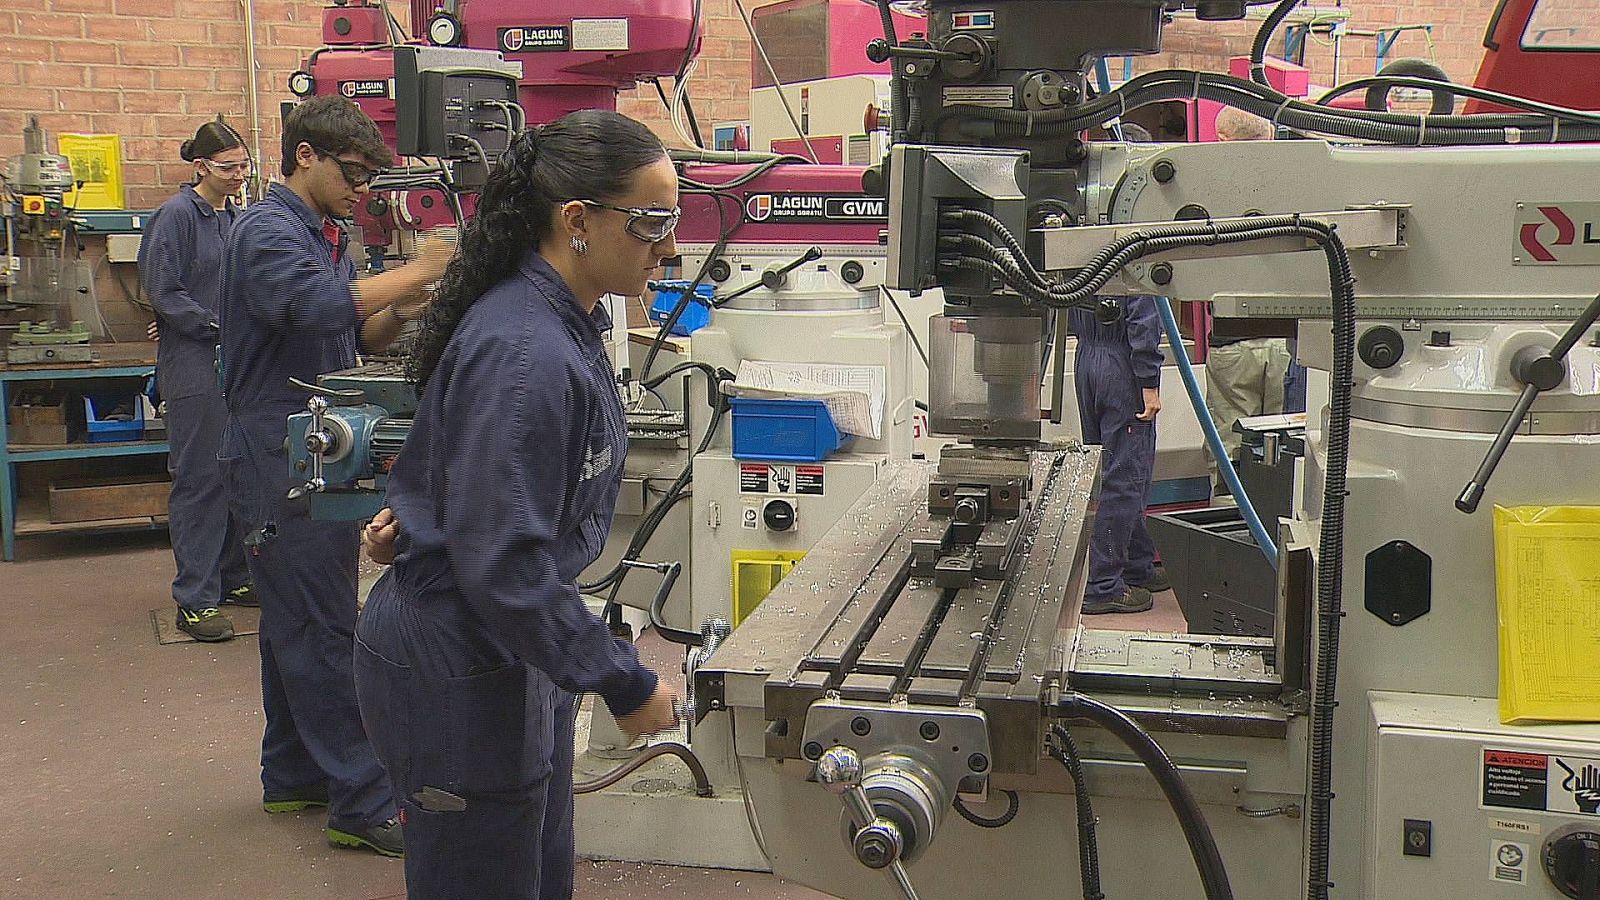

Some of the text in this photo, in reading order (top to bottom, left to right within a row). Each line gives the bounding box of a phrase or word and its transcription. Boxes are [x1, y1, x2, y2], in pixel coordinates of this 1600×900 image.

[524, 29, 563, 40] LAGUN
[356, 82, 383, 90] LAGUN
[773, 196, 883, 215] LAGUN GVM
